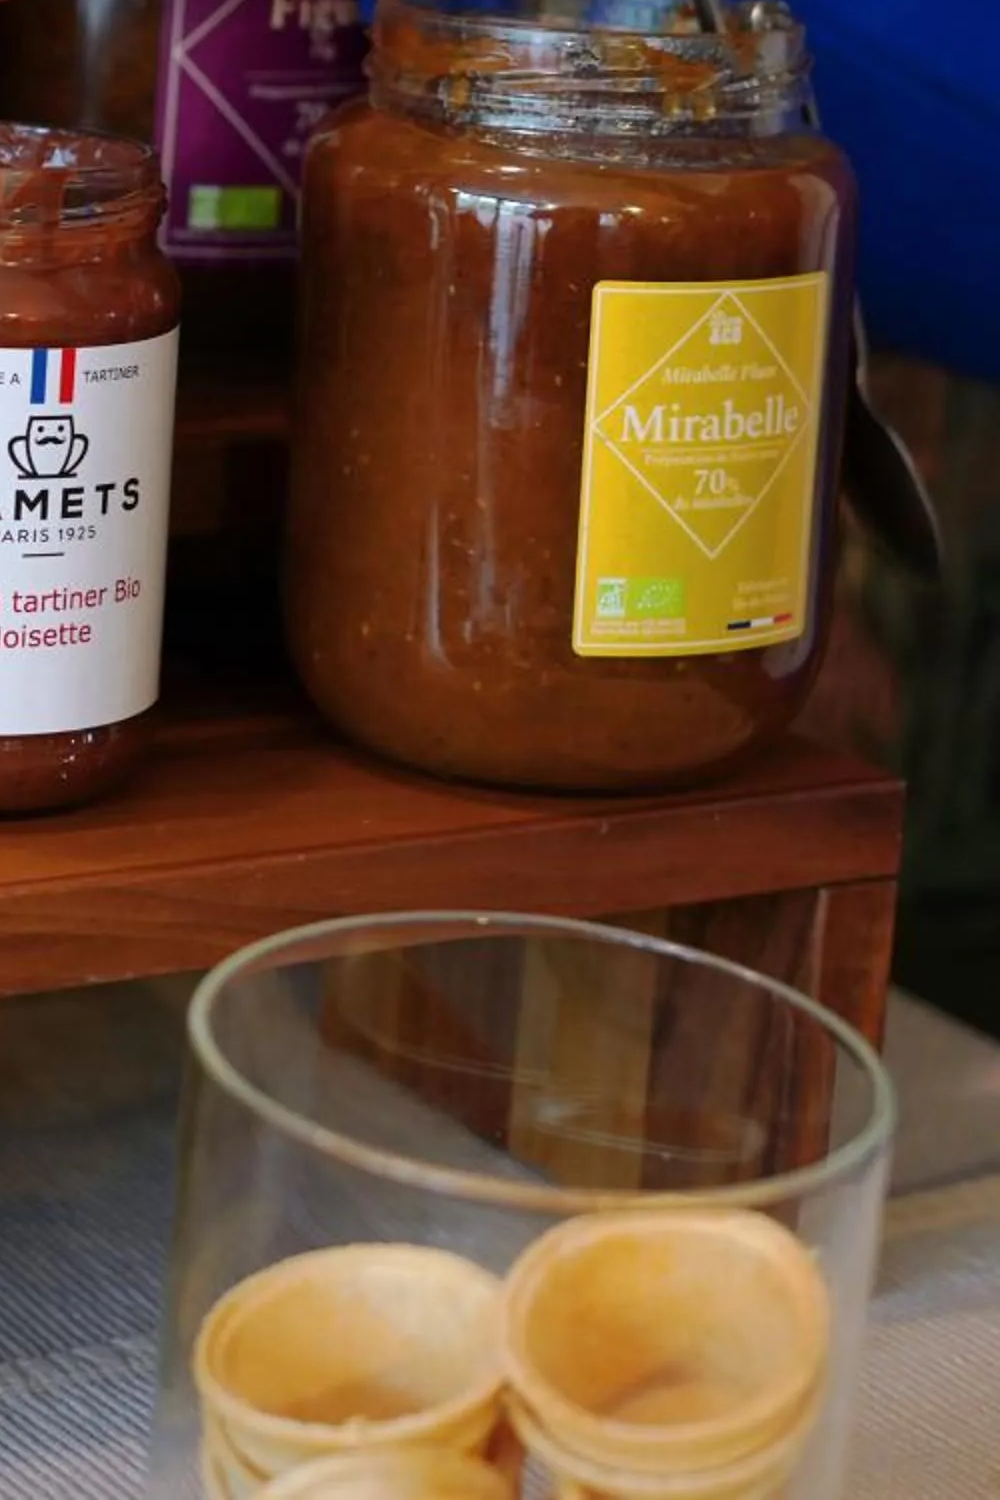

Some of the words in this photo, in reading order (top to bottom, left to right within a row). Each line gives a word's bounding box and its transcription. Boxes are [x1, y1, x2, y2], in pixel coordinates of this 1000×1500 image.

[9, 372, 21, 386] A
[82, 365, 140, 383] TARTINER
[620, 393, 799, 443] Mirabelle
[57, 525, 97, 542] 1925
[12, 585, 107, 614] tartiner
[114, 577, 141, 604] Bio
